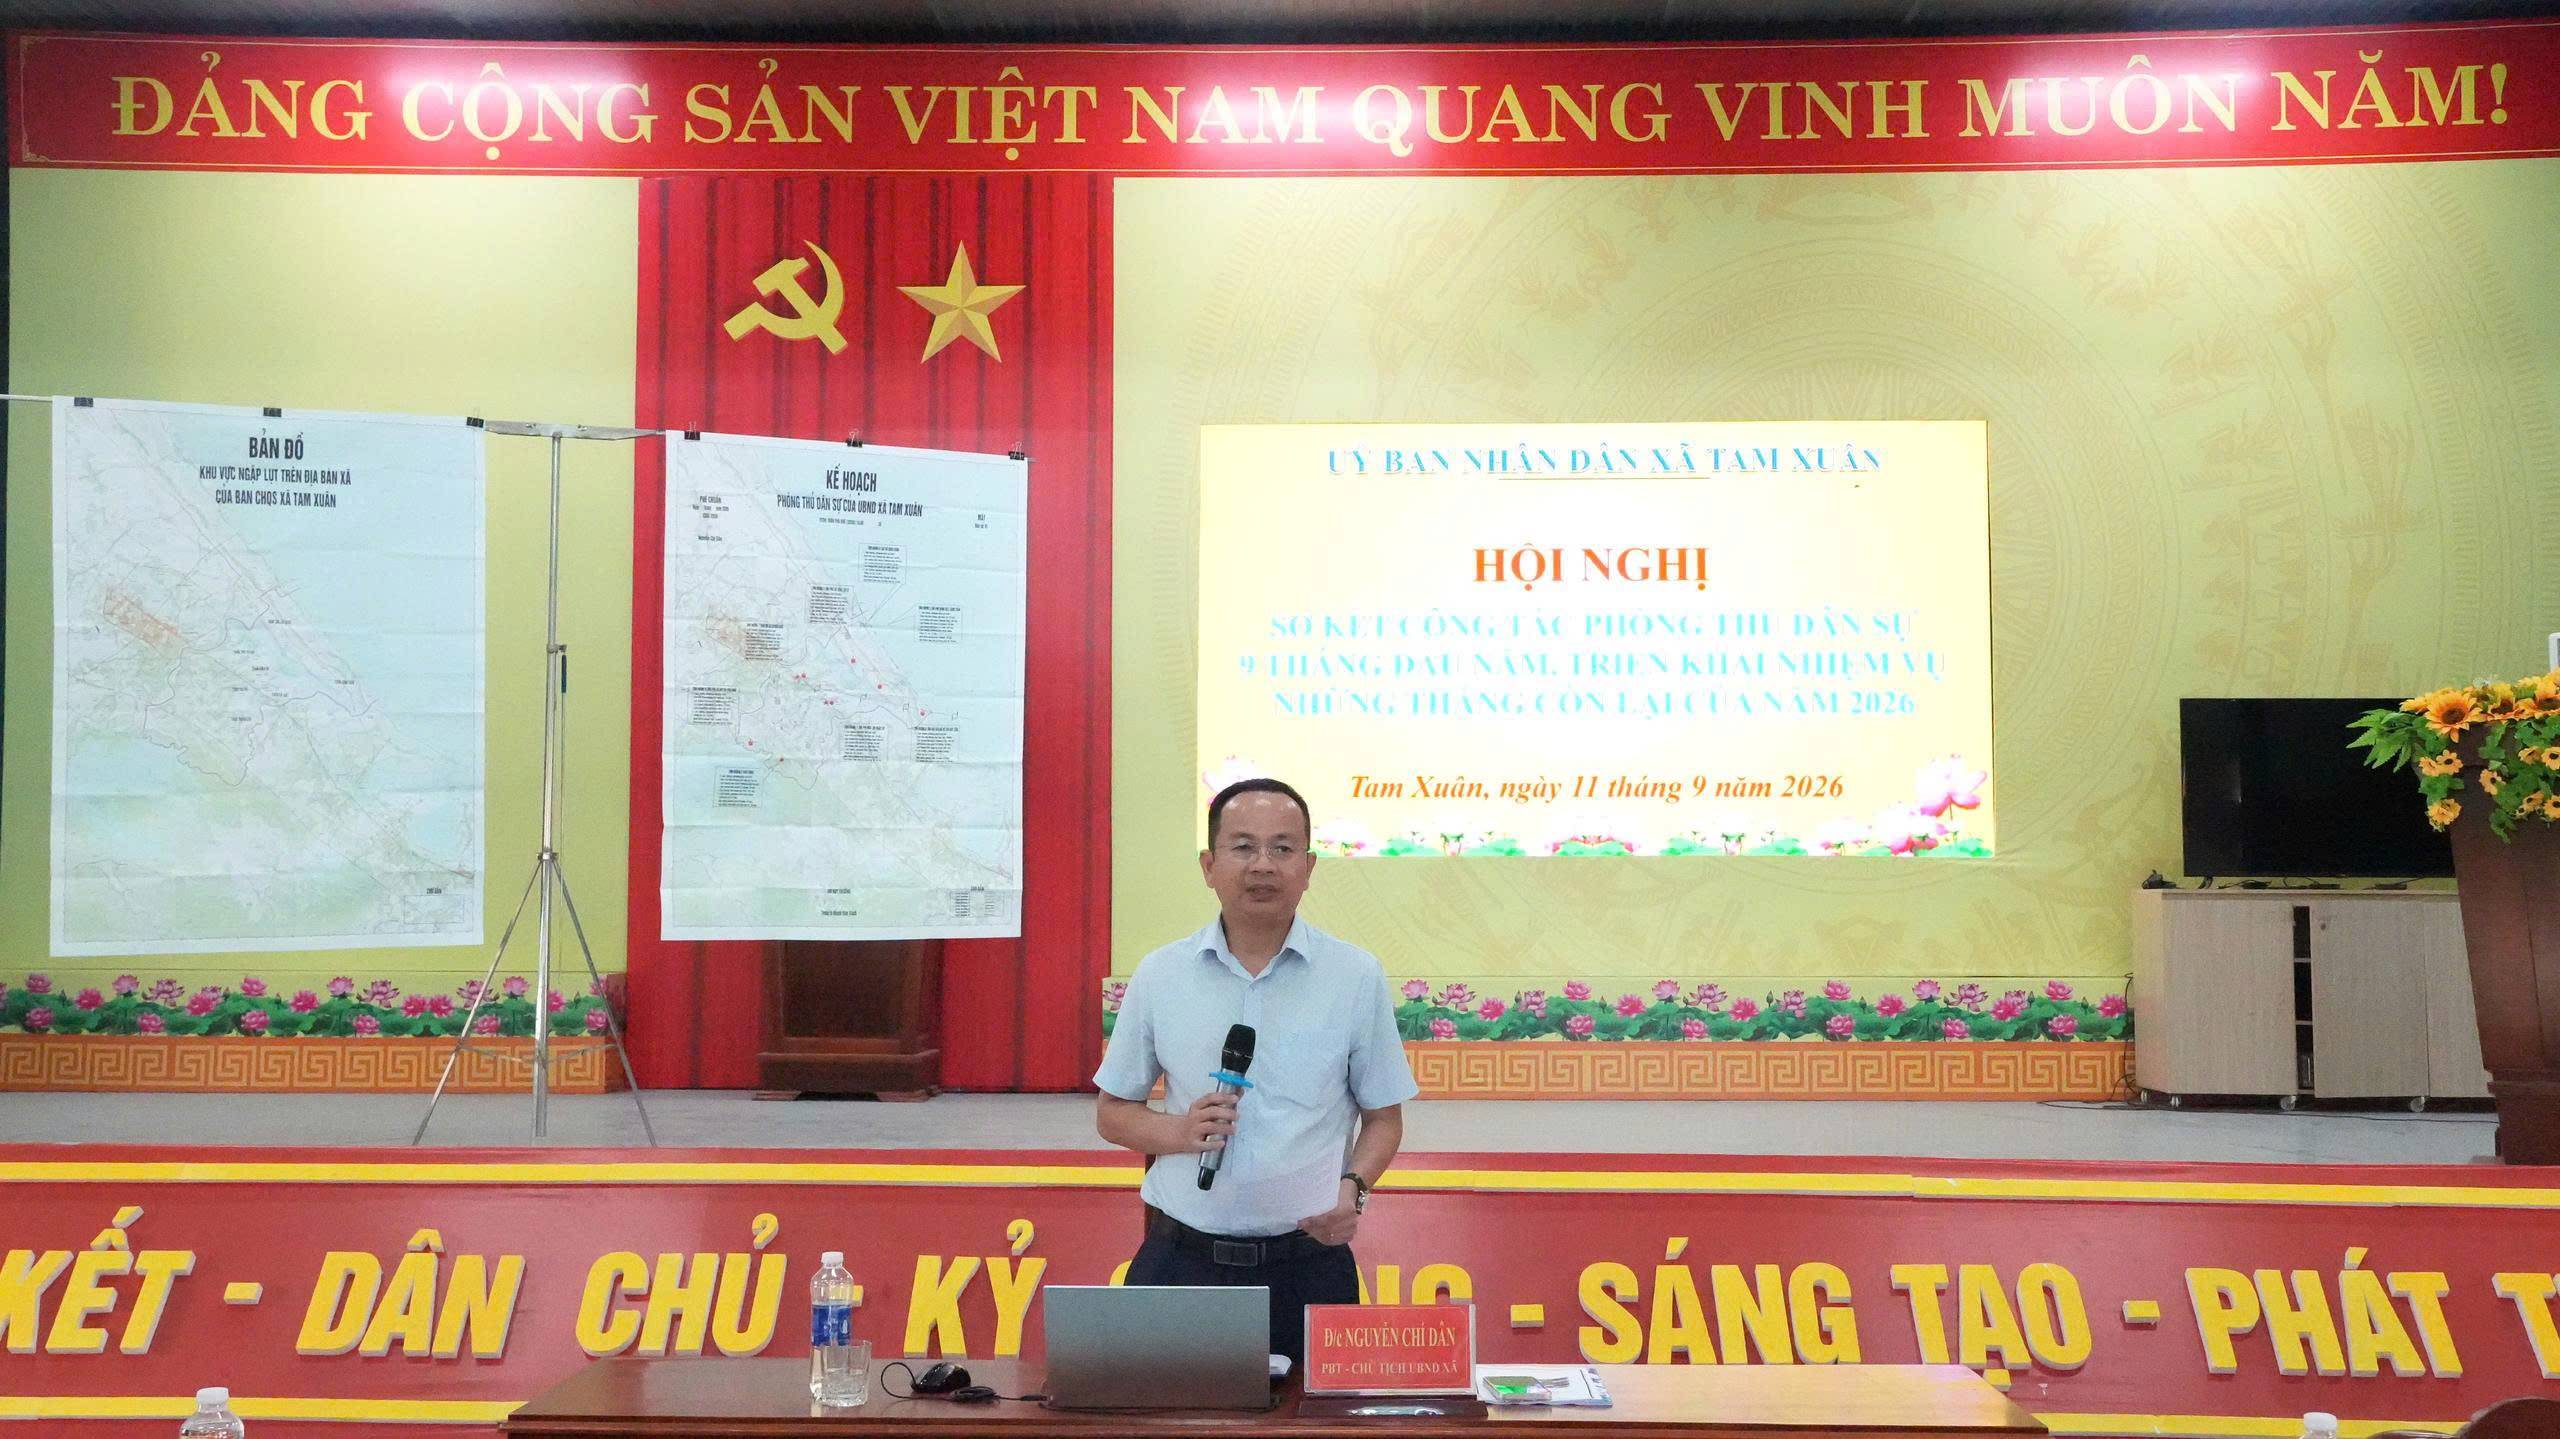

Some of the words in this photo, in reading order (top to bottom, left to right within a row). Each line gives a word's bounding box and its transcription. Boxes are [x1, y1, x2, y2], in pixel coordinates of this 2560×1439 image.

[111, 51, 372, 141] ĐẢNG
[402, 61, 659, 161] CỘNG
[684, 57, 855, 145] SẢN
[884, 66, 1096, 161] VIỆT
[1123, 84, 1324, 147] NAM
[1351, 82, 1672, 157] QUANG
[1695, 79, 1930, 141] VINH
[1957, 53, 2241, 139] MUÔN
[2270, 48, 2509, 131] NĂM!
[249, 428, 280, 459] BẢN
[1383, 449, 1451, 474] BAN
[1463, 441, 1557, 474] NHÂN
[1569, 441, 1638, 474] DÂN
[1650, 441, 1696, 473] XÃ
[1706, 447, 1780, 473] TAM
[1791, 443, 1884, 473] XUÂN
[200, 465, 217, 480] KHU
[826, 463, 840, 490] KẾ
[842, 470, 877, 496] HOẠCH
[235, 489, 253, 505] BAN
[293, 492, 311, 507] TAM
[888, 502, 903, 516] TAM
[1474, 542, 1563, 591] HỘI
[1581, 547, 1711, 591] NGHỊ
[1849, 690, 1918, 715] 2026
[1350, 775, 1403, 799] Tam
[1411, 774, 1490, 802] Xuân,
[1500, 774, 1562, 804] ngày
[1572, 775, 1599, 799] 11
[1608, 774, 1681, 804] tháng
[1692, 775, 1707, 799] 9
[1716, 774, 1773, 799] năm
[1781, 775, 1845, 799] 2026
[0, 1206, 197, 1354] KẾT
[296, 1229, 527, 1359] DÂN
[575, 1213, 788, 1358] CHỦ
[903, 1219, 1048, 1361] KỶ
[1578, 1236, 1862, 1365] SÁNG
[1890, 1262, 2092, 1392] TẠO
[2185, 1246, 2464, 1378] PHÁT
[2491, 1272, 2560, 1380] T
[1345, 1320, 1399, 1347] NGUYỄN
[1402, 1320, 1425, 1347] CHÍ
[1429, 1319, 1456, 1347] DÂN
[1321, 1362, 1343, 1374] PBT
[1409, 1362, 1440, 1374] UBND
